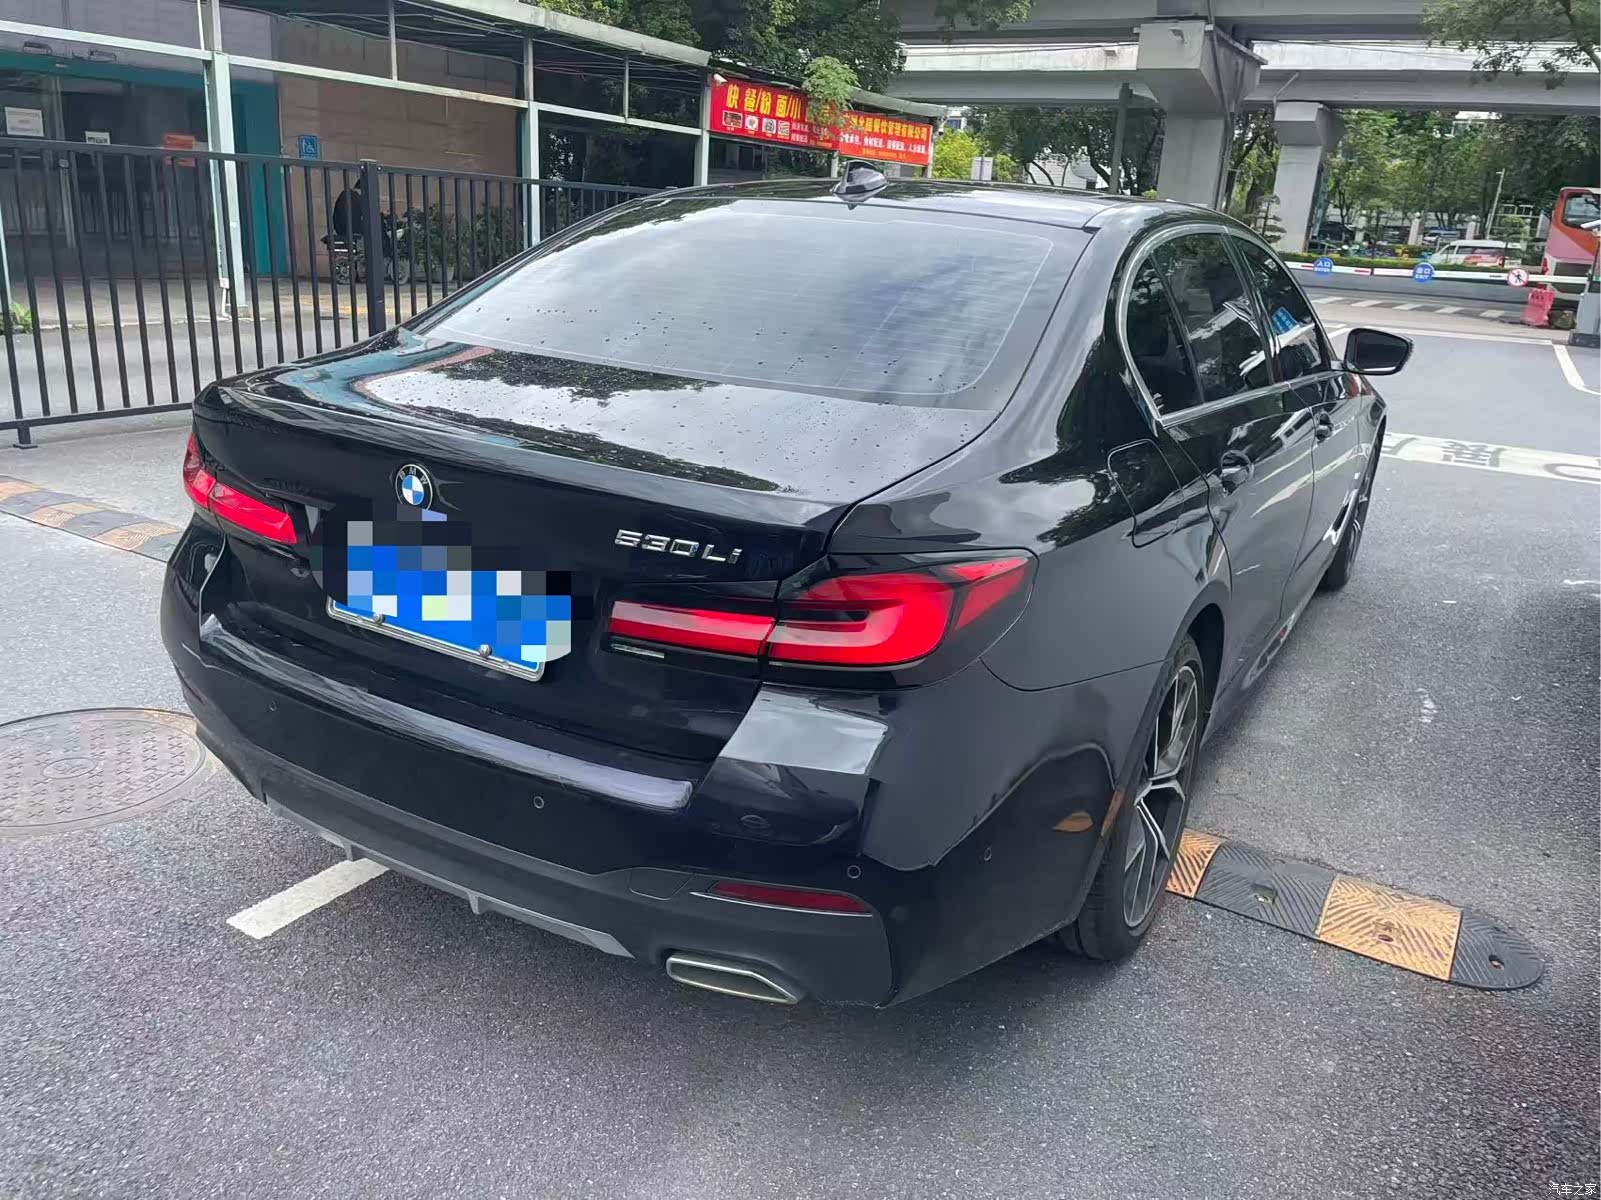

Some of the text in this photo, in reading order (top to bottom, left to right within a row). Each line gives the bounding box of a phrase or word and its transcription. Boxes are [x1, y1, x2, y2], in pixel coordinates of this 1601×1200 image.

[1316, 260, 1331, 268] 入口
[1415, 267, 1431, 275] 出口
[399, 466, 428, 485] BMW
[614, 528, 744, 565] 530Li
